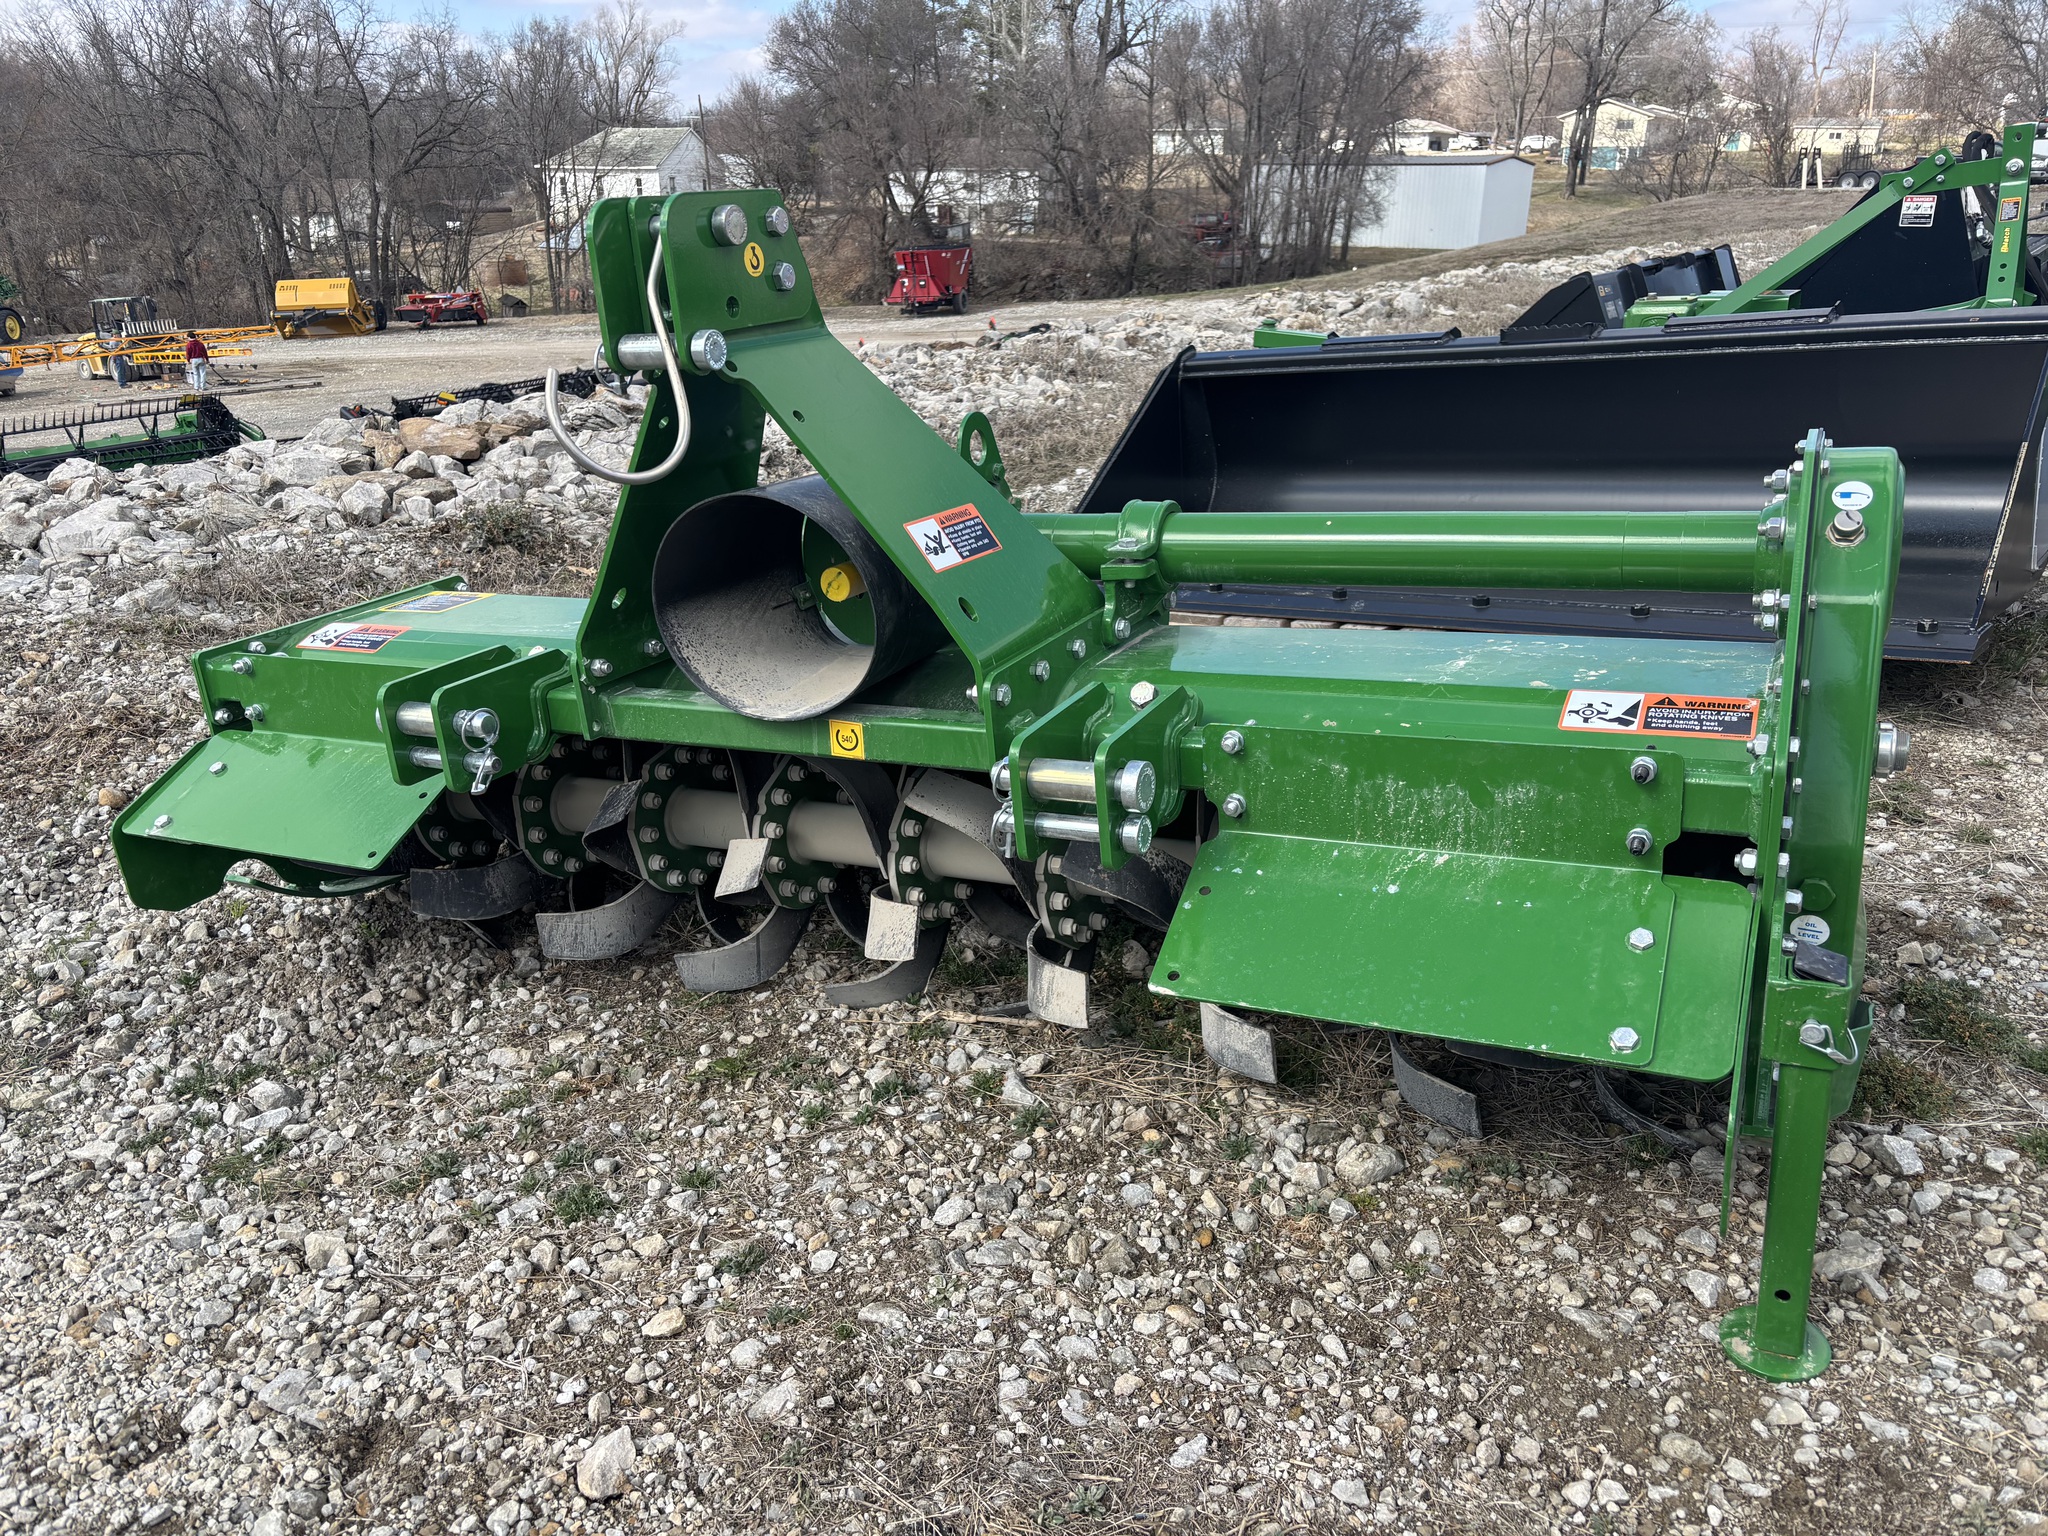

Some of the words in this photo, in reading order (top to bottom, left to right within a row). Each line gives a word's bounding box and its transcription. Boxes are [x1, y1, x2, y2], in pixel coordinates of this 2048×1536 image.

[943, 509, 972, 522] WARNING
[1684, 700, 1752, 710] WARNING
[842, 734, 853, 744] 540
[1798, 932, 1820, 940] LEVEL
